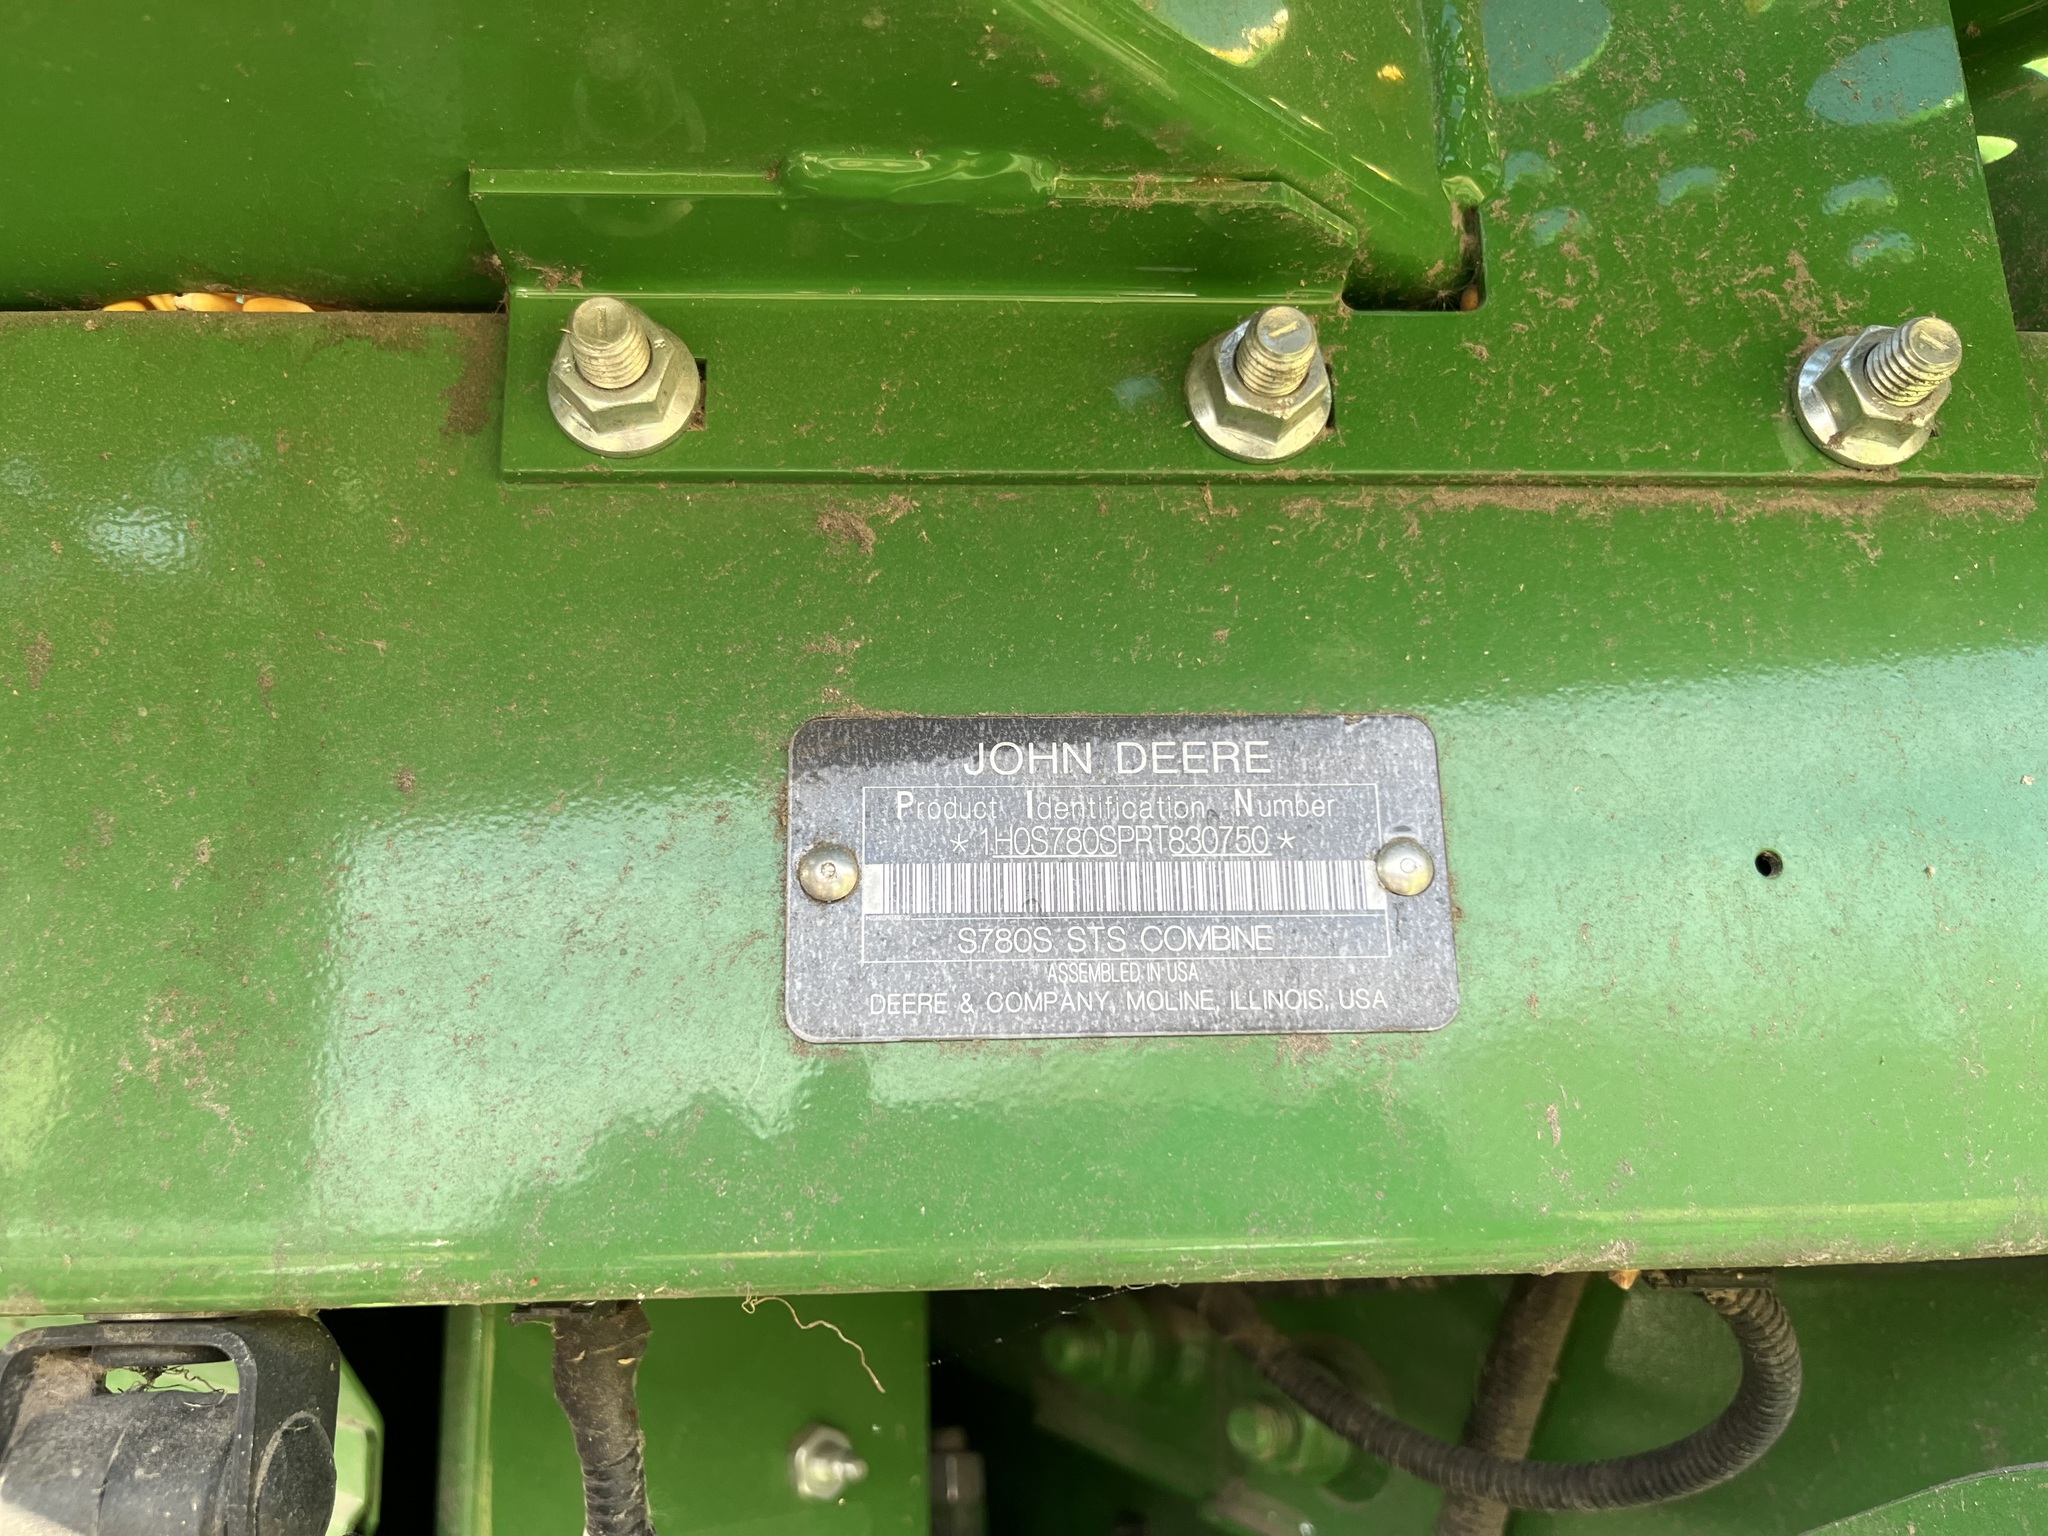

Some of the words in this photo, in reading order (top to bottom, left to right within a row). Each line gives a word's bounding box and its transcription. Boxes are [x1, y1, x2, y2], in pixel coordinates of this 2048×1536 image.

[963, 741, 1093, 776] JOHN
[1115, 740, 1272, 775] DEERE
[896, 790, 998, 821] Product
[1026, 789, 1206, 820] Identification
[1234, 788, 1336, 818] Number
[957, 926, 1053, 954] S780S
[1066, 925, 1127, 953] STS
[1140, 924, 1274, 952] COMBINE
[1047, 961, 1141, 984] ASSEMBLED
[1146, 962, 1161, 983] IN
[1166, 961, 1200, 983] USA
[869, 993, 948, 1015] DEERE
[959, 994, 975, 1014] &
[1126, 989, 1220, 1014] MOLINE,
[1230, 988, 1330, 1013] ILLINOIS,
[1338, 988, 1389, 1010] USA
